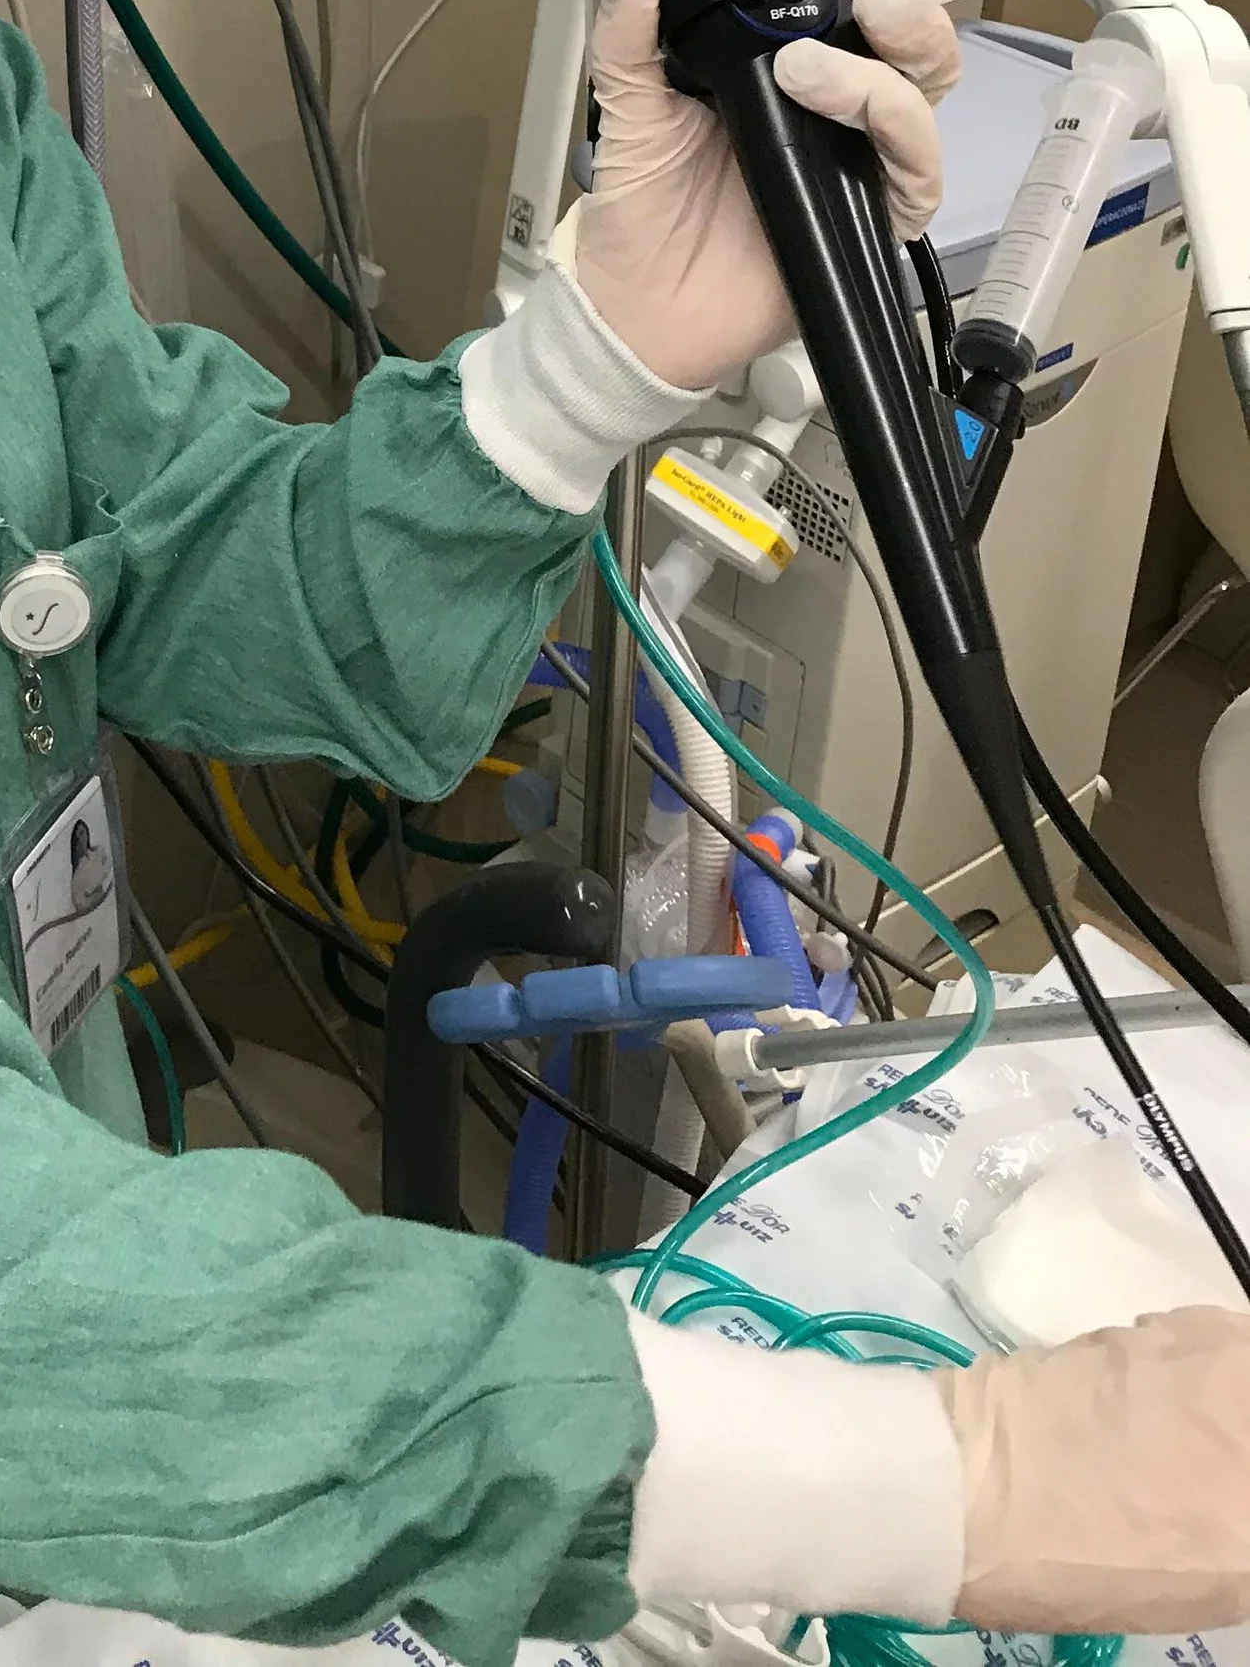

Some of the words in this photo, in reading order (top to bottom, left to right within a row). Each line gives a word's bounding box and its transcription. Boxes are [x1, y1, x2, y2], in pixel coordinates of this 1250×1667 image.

[770, 5, 819, 20] BF-Q170
[1142, 1092, 1195, 1173] OLYMPUS
[731, 1316, 772, 1352] RED
